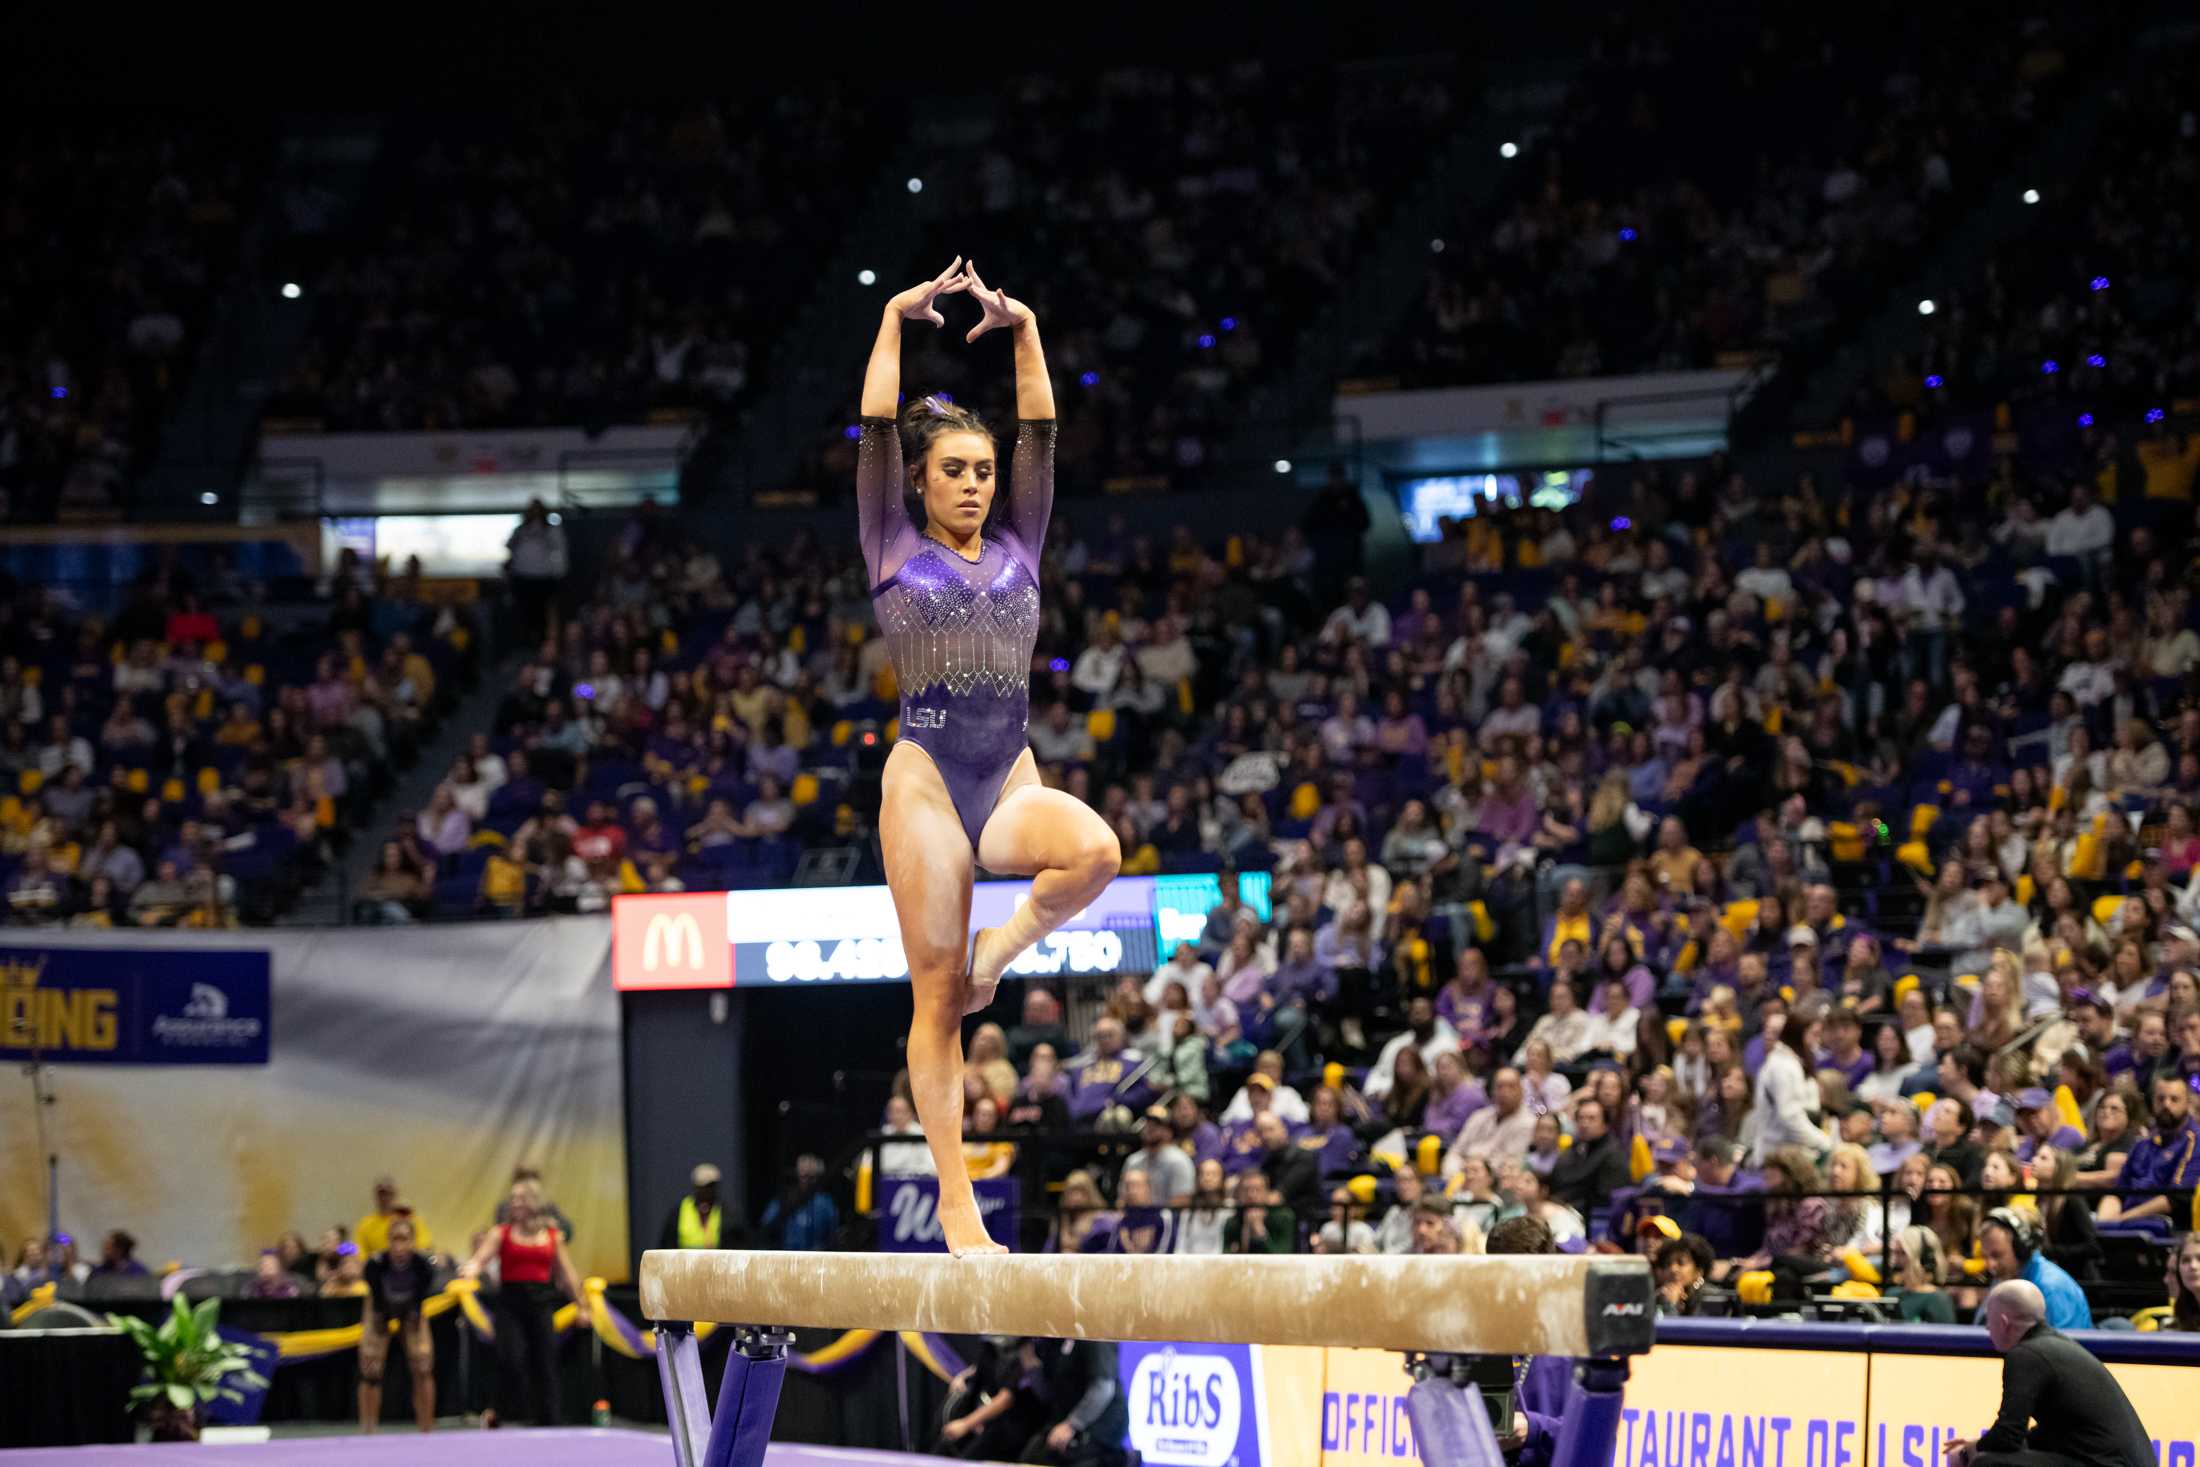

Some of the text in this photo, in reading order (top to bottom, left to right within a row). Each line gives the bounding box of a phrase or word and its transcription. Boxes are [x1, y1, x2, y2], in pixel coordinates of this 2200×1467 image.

[906, 706, 947, 729] LSU
[1322, 1391, 1417, 1457] OFFIC
[1621, 1408, 1791, 1467] TAURANT
